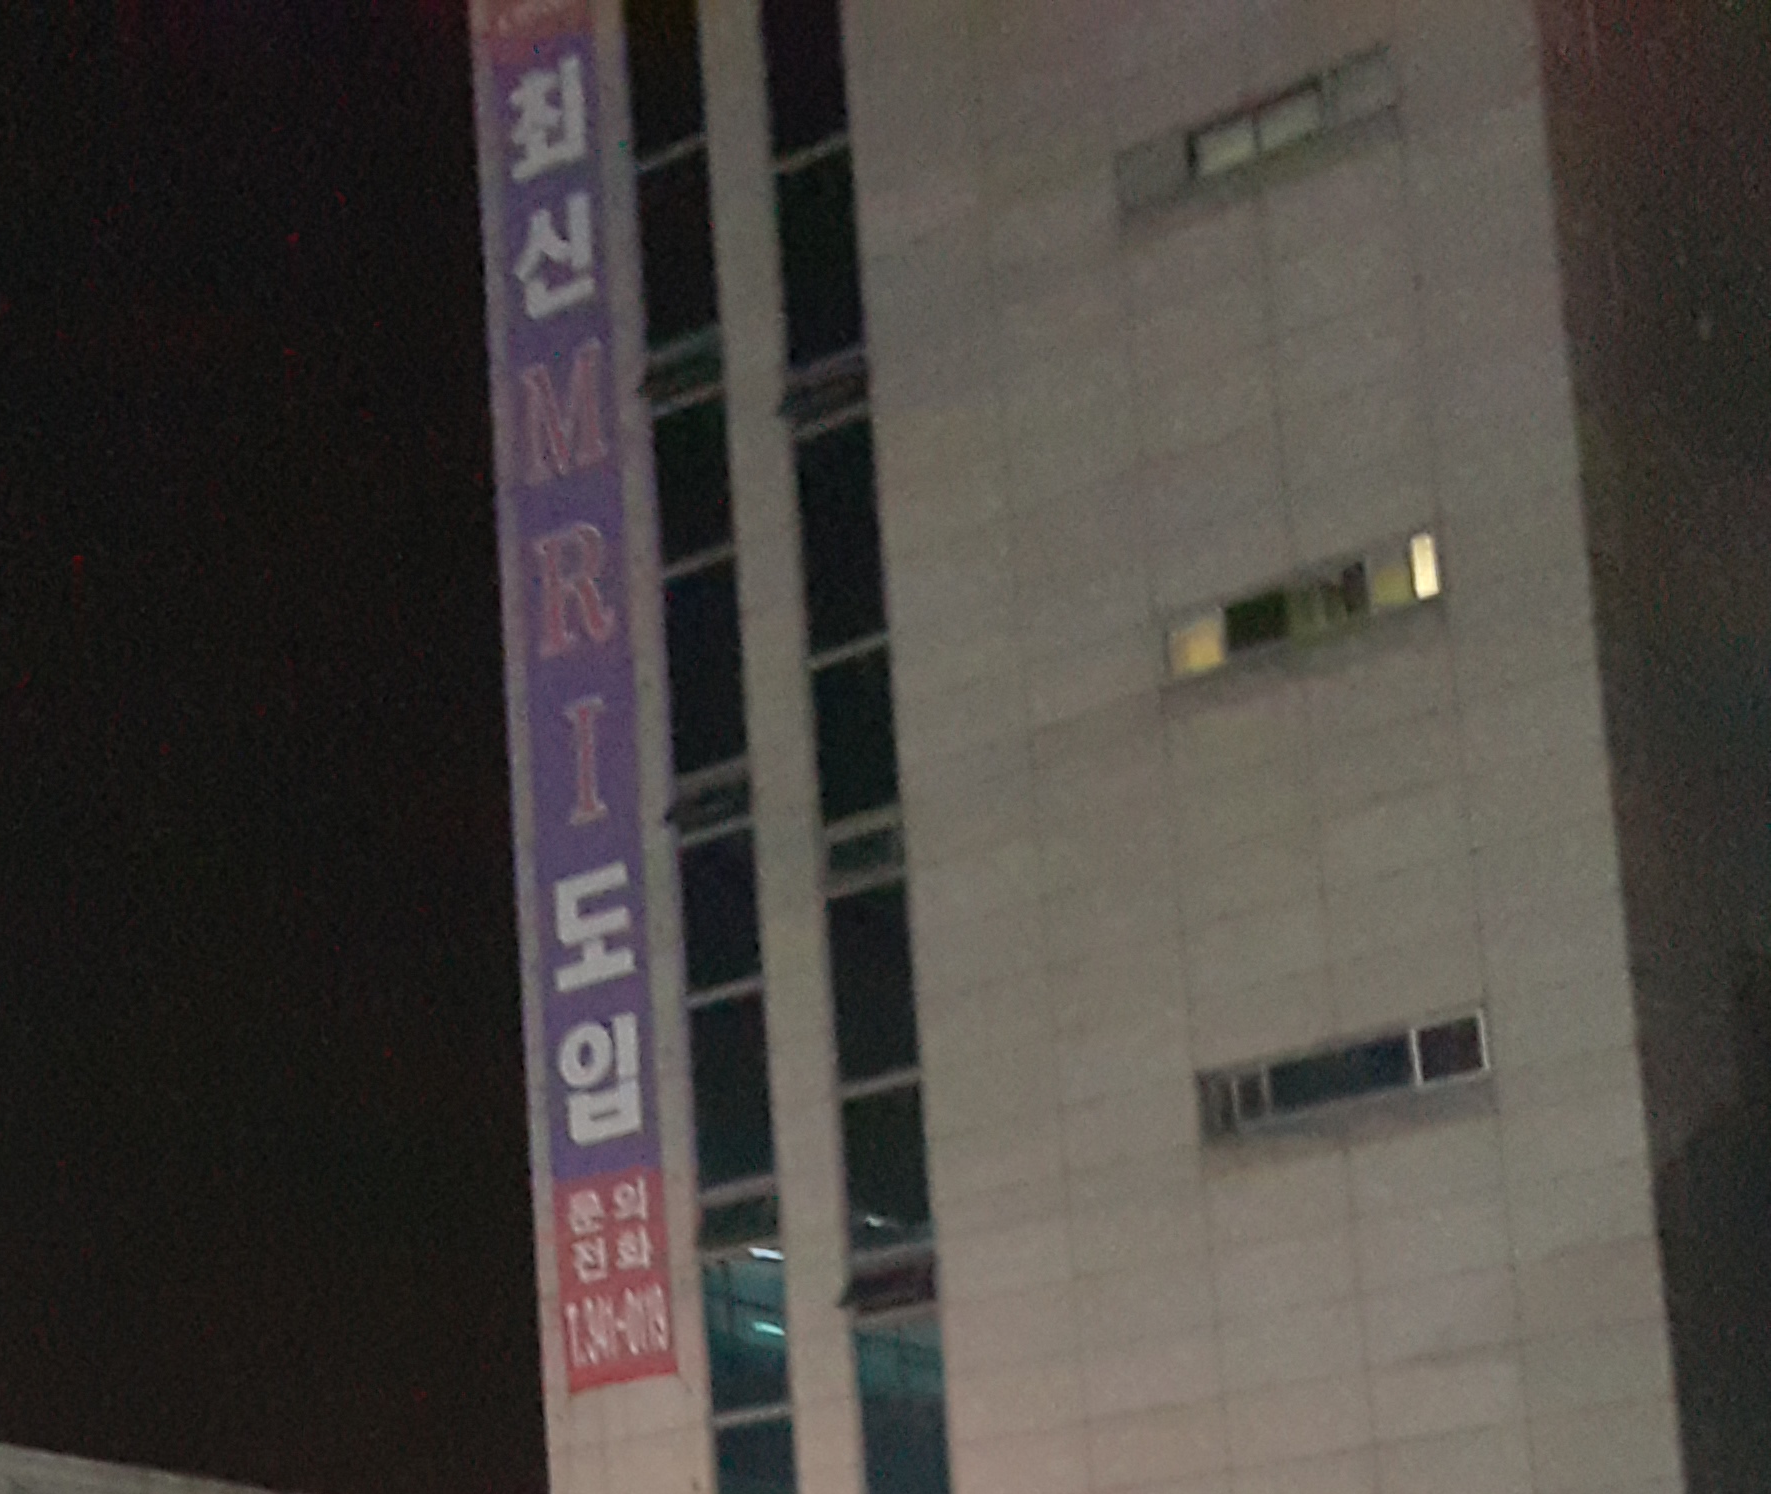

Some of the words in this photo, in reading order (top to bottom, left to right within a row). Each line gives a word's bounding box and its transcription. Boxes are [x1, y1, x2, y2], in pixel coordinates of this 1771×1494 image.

[509, 54, 598, 320] 최신
[519, 338, 616, 826] MRI
[552, 861, 644, 1148] 도입
[568, 1176, 648, 1235] 문의
[571, 1226, 653, 1284] 전화
